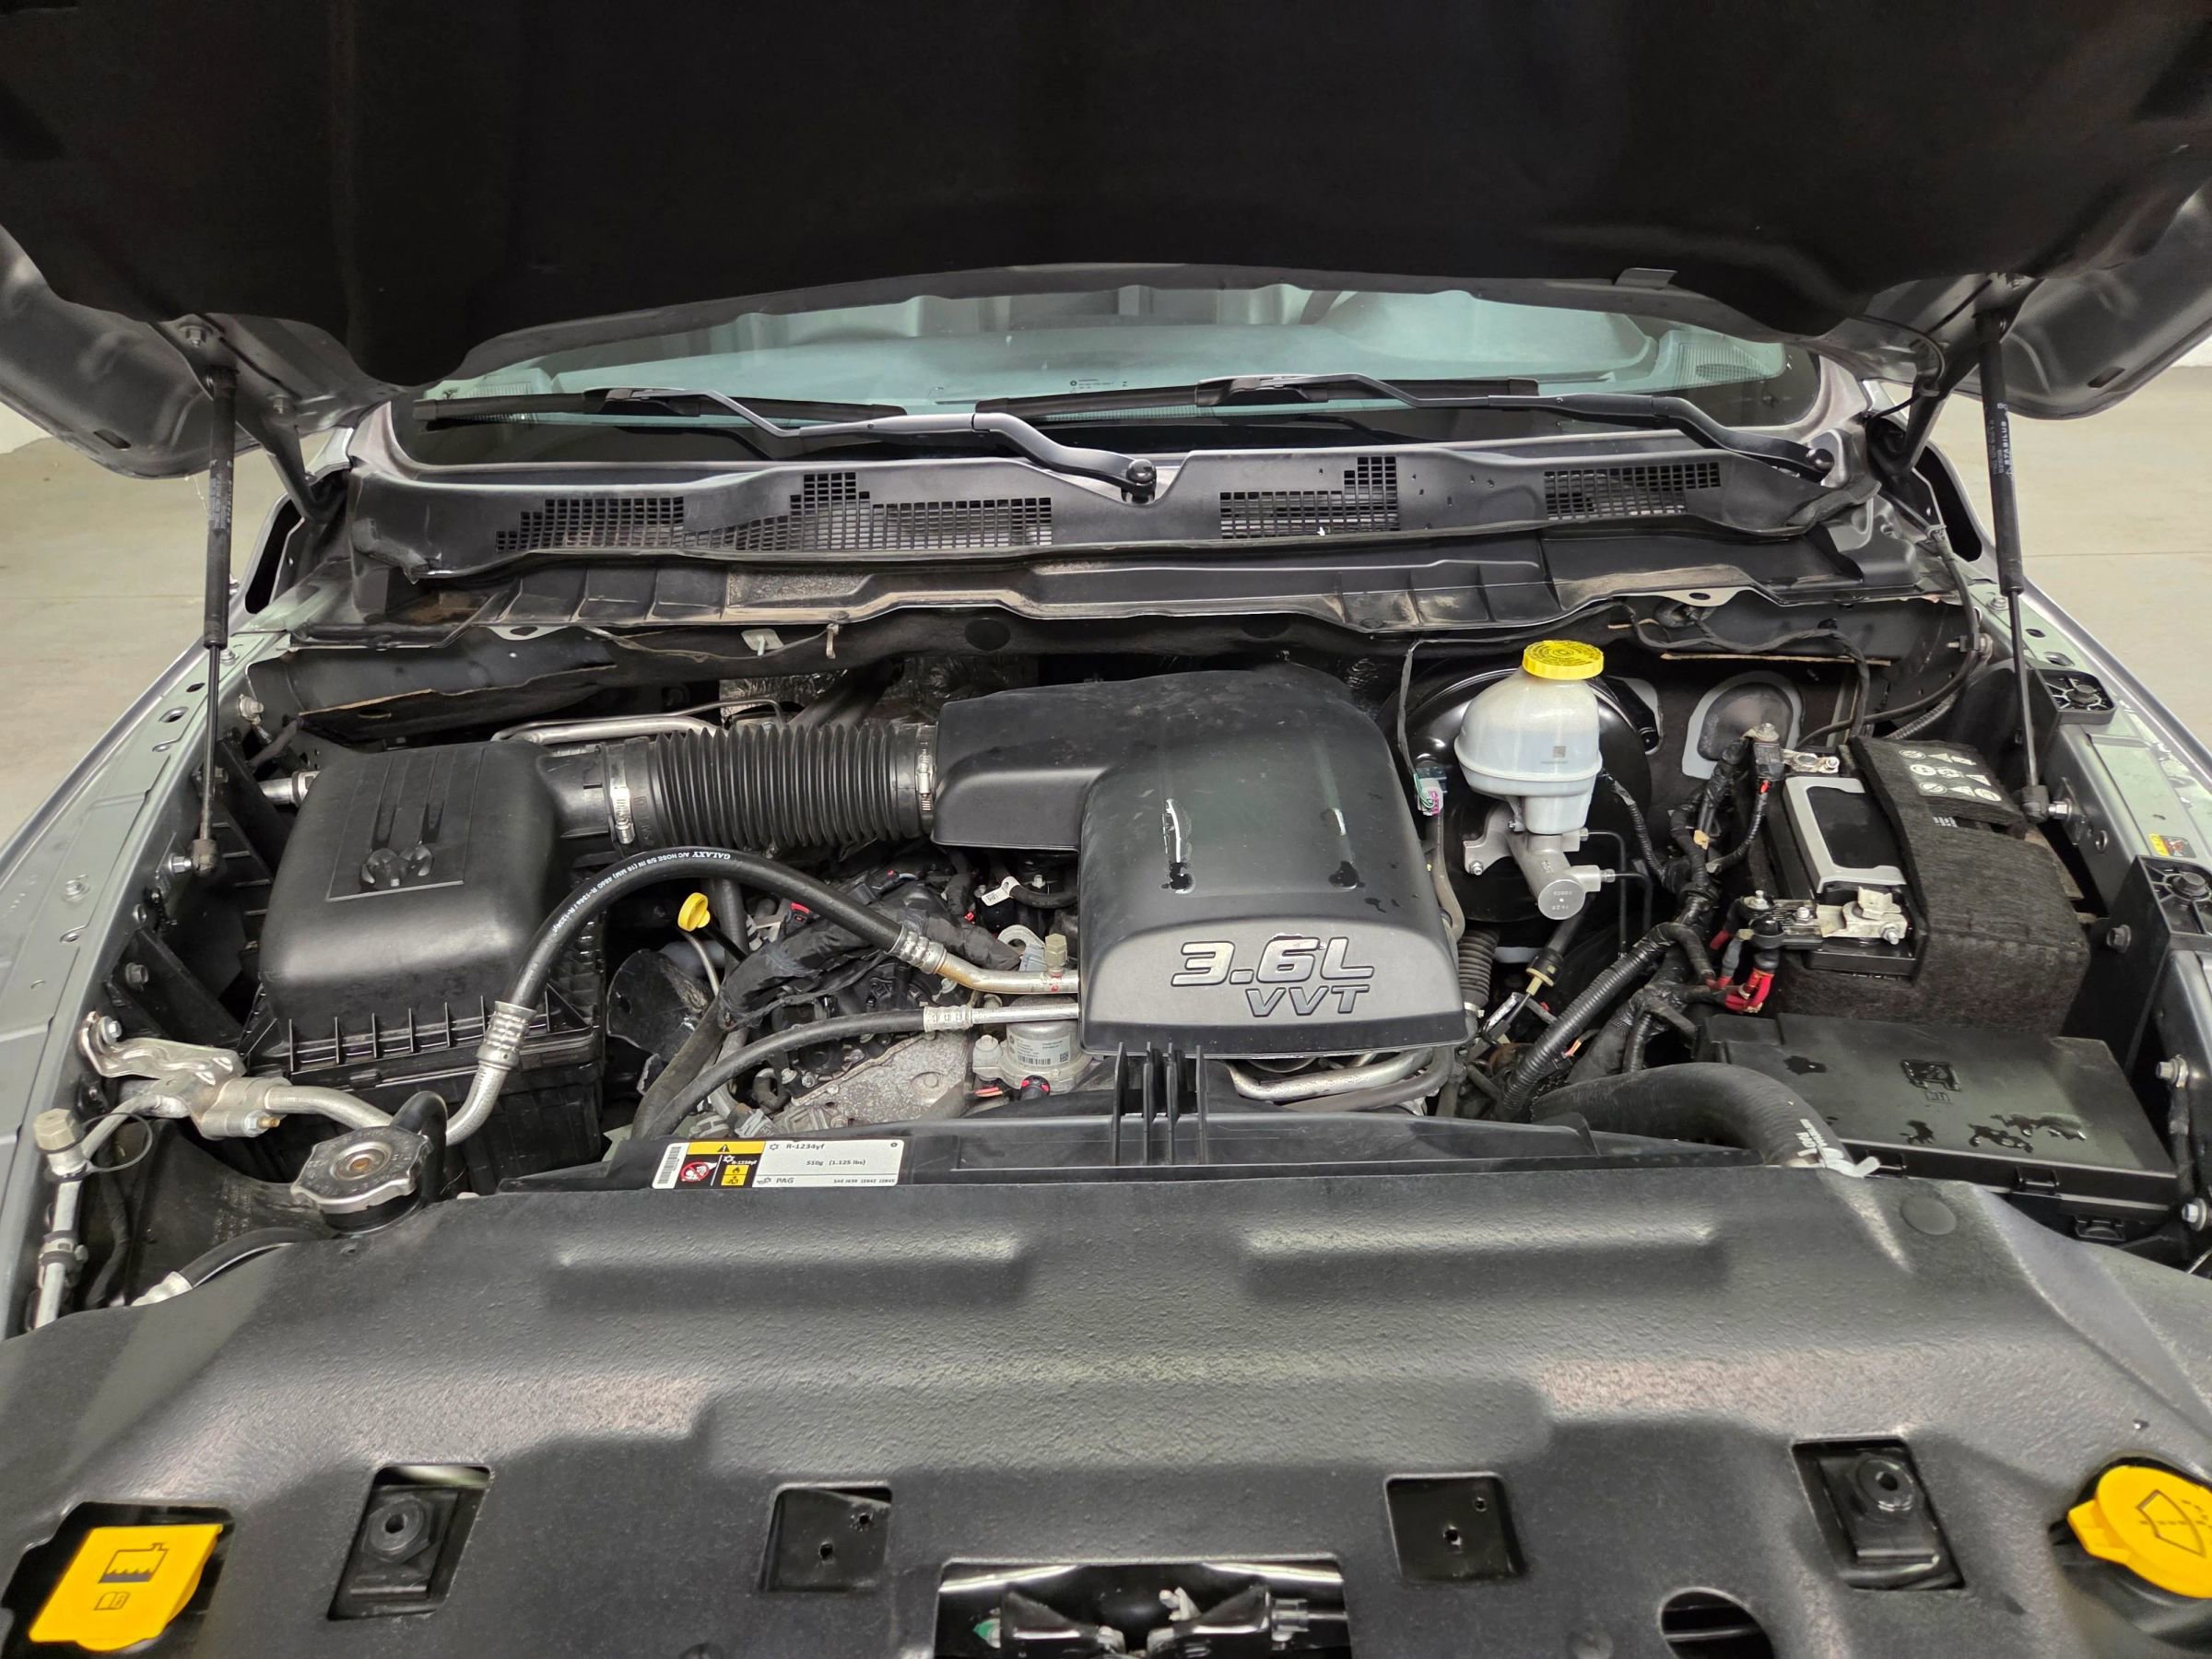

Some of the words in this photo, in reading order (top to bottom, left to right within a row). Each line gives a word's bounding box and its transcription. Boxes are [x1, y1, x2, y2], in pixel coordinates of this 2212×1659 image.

[657, 853, 677, 862] HOSE
[692, 851, 731, 860] GALAXY
[638, 860, 647, 868] IN
[646, 857, 657, 865] 5/8
[1171, 935, 1375, 987] 3.6L
[1244, 984, 1371, 1018] VVT
